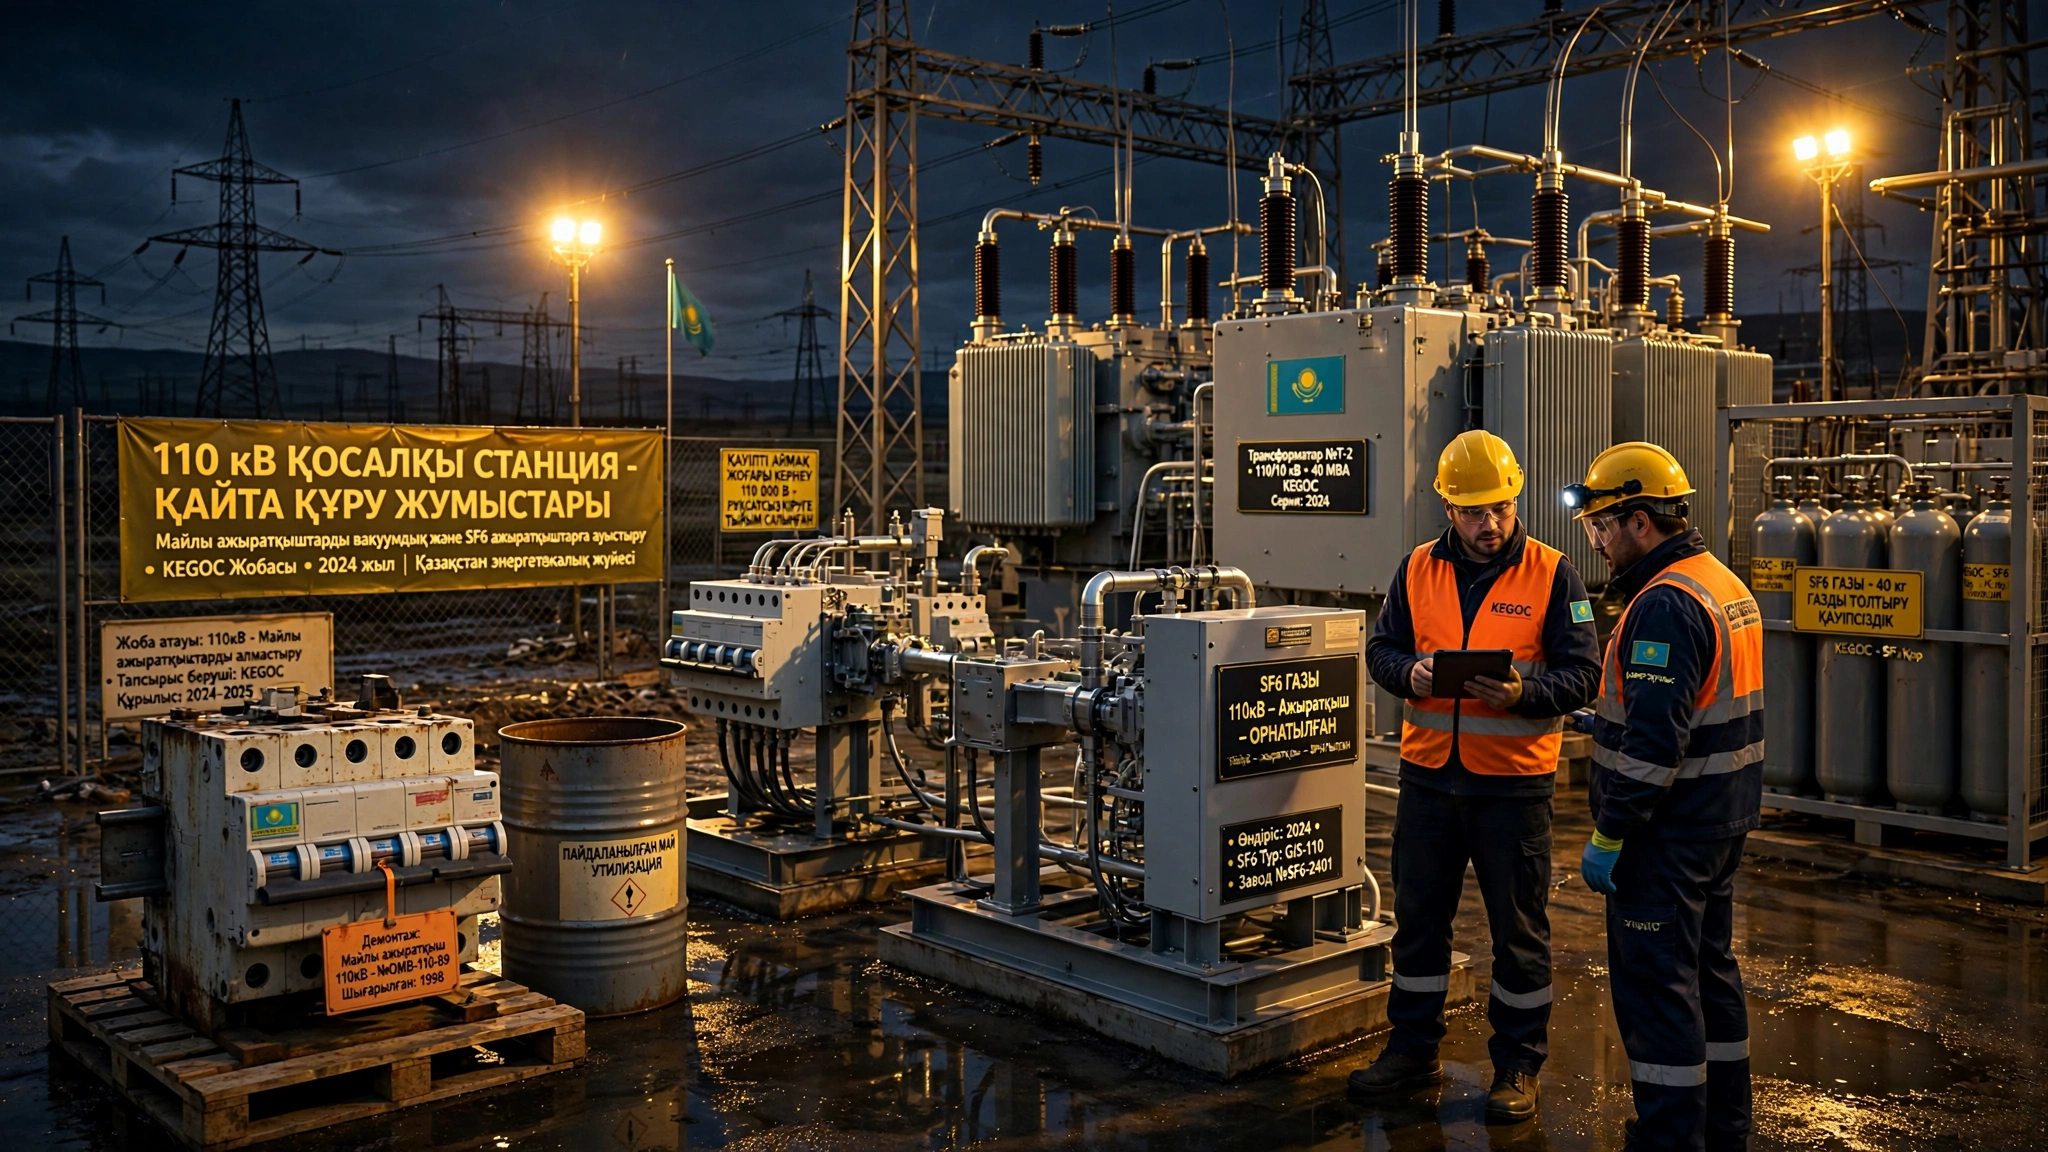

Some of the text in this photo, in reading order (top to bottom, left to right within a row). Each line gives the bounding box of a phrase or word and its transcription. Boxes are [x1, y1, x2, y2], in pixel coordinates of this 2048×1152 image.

[153, 442, 219, 477] 110
[230, 444, 277, 477] кВ
[288, 445, 463, 484] ҚОСАЛҚЫ
[473, 449, 619, 485] СТАНЦИЯ
[1255, 463, 1287, 478] 110/10
[1311, 464, 1324, 477] 40
[741, 485, 758, 497] 110
[761, 485, 779, 497] 000
[1283, 479, 1319, 493] KEGOC
[156, 480, 611, 527] ҚАЙТА ҚҰРУ ЖУМЫСТАРЫ
[1305, 494, 1331, 507] 2024
[156, 533, 213, 550] Майлы
[217, 534, 350, 552] ажыратқыштарды
[353, 533, 429, 550] вакуумдық
[465, 529, 489, 545] SF6
[592, 530, 647, 546] ауыстыру
[163, 559, 225, 578] KEGOC
[228, 557, 297, 576] Жобасы
[318, 556, 358, 574] 2024
[361, 558, 396, 573] жыл
[415, 553, 488, 575] Қазақстан
[1809, 575, 1829, 590] SF6
[1832, 576, 1864, 591] ГАЗЫ
[1876, 578, 1892, 592] 40
[1894, 582, 1907, 593] кг
[1490, 602, 1532, 617] KEGOC
[1807, 592, 1909, 610] ГАЗДЫ ТОЛТЫРУ
[1818, 610, 1894, 630] ҚАУІПСІЗДІК
[115, 634, 155, 650] Жоба
[159, 637, 203, 650] атауы:
[208, 631, 246, 646] 110кВ
[258, 629, 302, 644] Майлы
[117, 673, 184, 688] Тапсырыс
[241, 665, 284, 680] KEGOC
[1260, 670, 1320, 693] SF6 ГАЗЫ
[117, 692, 182, 710] Құрылыс:
[1228, 700, 1266, 721] 110кВ
[1278, 695, 1350, 718] Ажыратқыш
[1249, 717, 1337, 745] ОРНАТЫЛҒАН
[1238, 820, 1312, 847] Өндіріс: 2024
[591, 856, 663, 877] УТИЛИЗАЦИЯ
[1237, 851, 1258, 869] SF6
[1238, 856, 1333, 890] Завод №SF6-2401
[361, 929, 421, 951] Демонтаж:
[341, 951, 379, 968] Майлы
[336, 968, 368, 985] 110кВ
[342, 971, 445, 1001] Шығарылған: 1998
